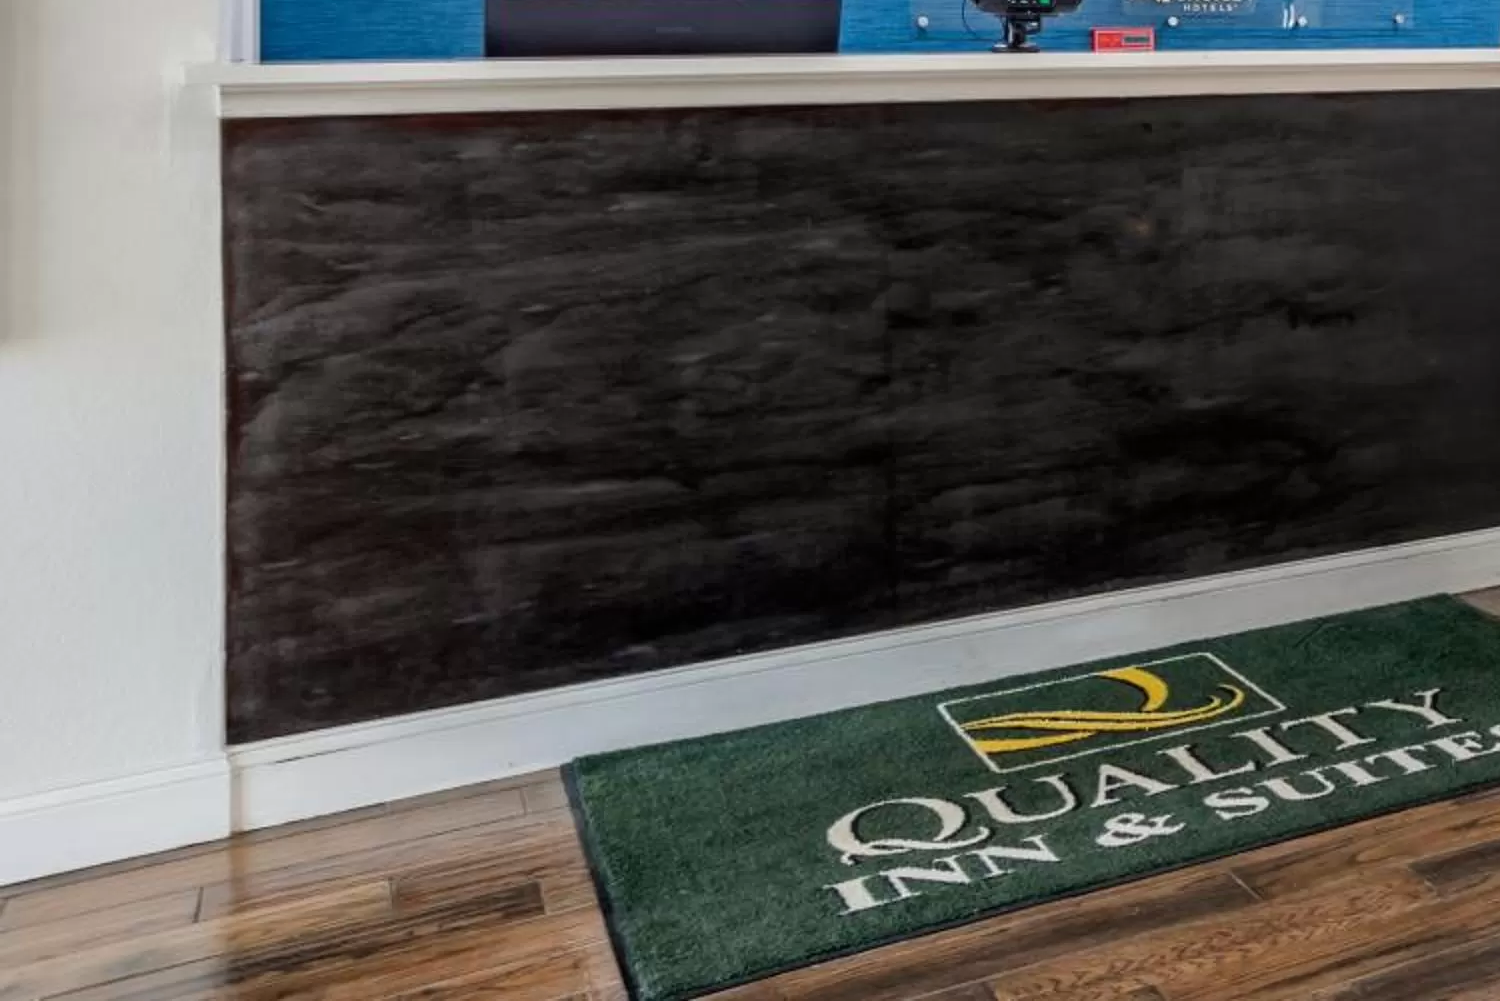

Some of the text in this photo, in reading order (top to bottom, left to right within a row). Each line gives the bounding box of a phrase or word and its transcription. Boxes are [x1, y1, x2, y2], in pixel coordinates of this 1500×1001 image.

[825, 687, 1464, 865] QUALITY
[822, 833, 1062, 914] INN
[1095, 810, 1185, 848] &
